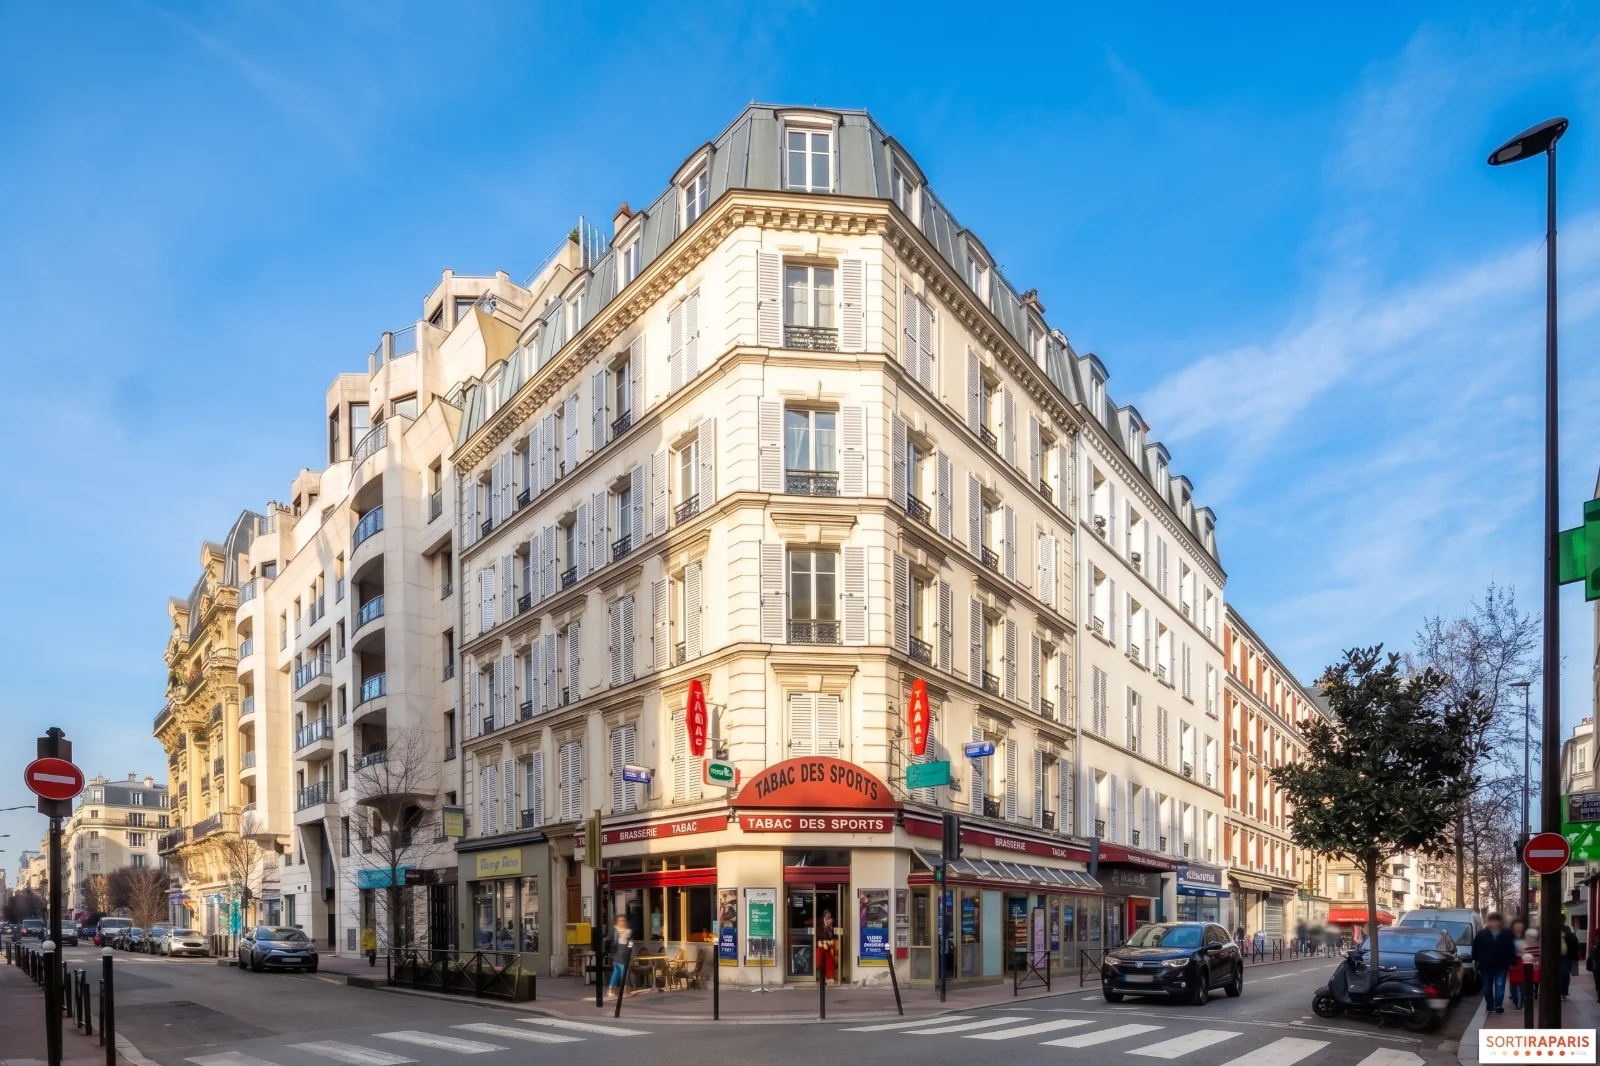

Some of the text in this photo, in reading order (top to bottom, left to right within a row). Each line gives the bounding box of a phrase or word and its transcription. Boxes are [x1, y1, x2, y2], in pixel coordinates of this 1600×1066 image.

[755, 763, 878, 800] TABAC DES SPORTS
[619, 827, 658, 841] BRASSERIE
[671, 821, 697, 834] TABAC
[748, 818, 884, 830] TABAC DES SPORTS
[994, 837, 1026, 851] BRASSERIE
